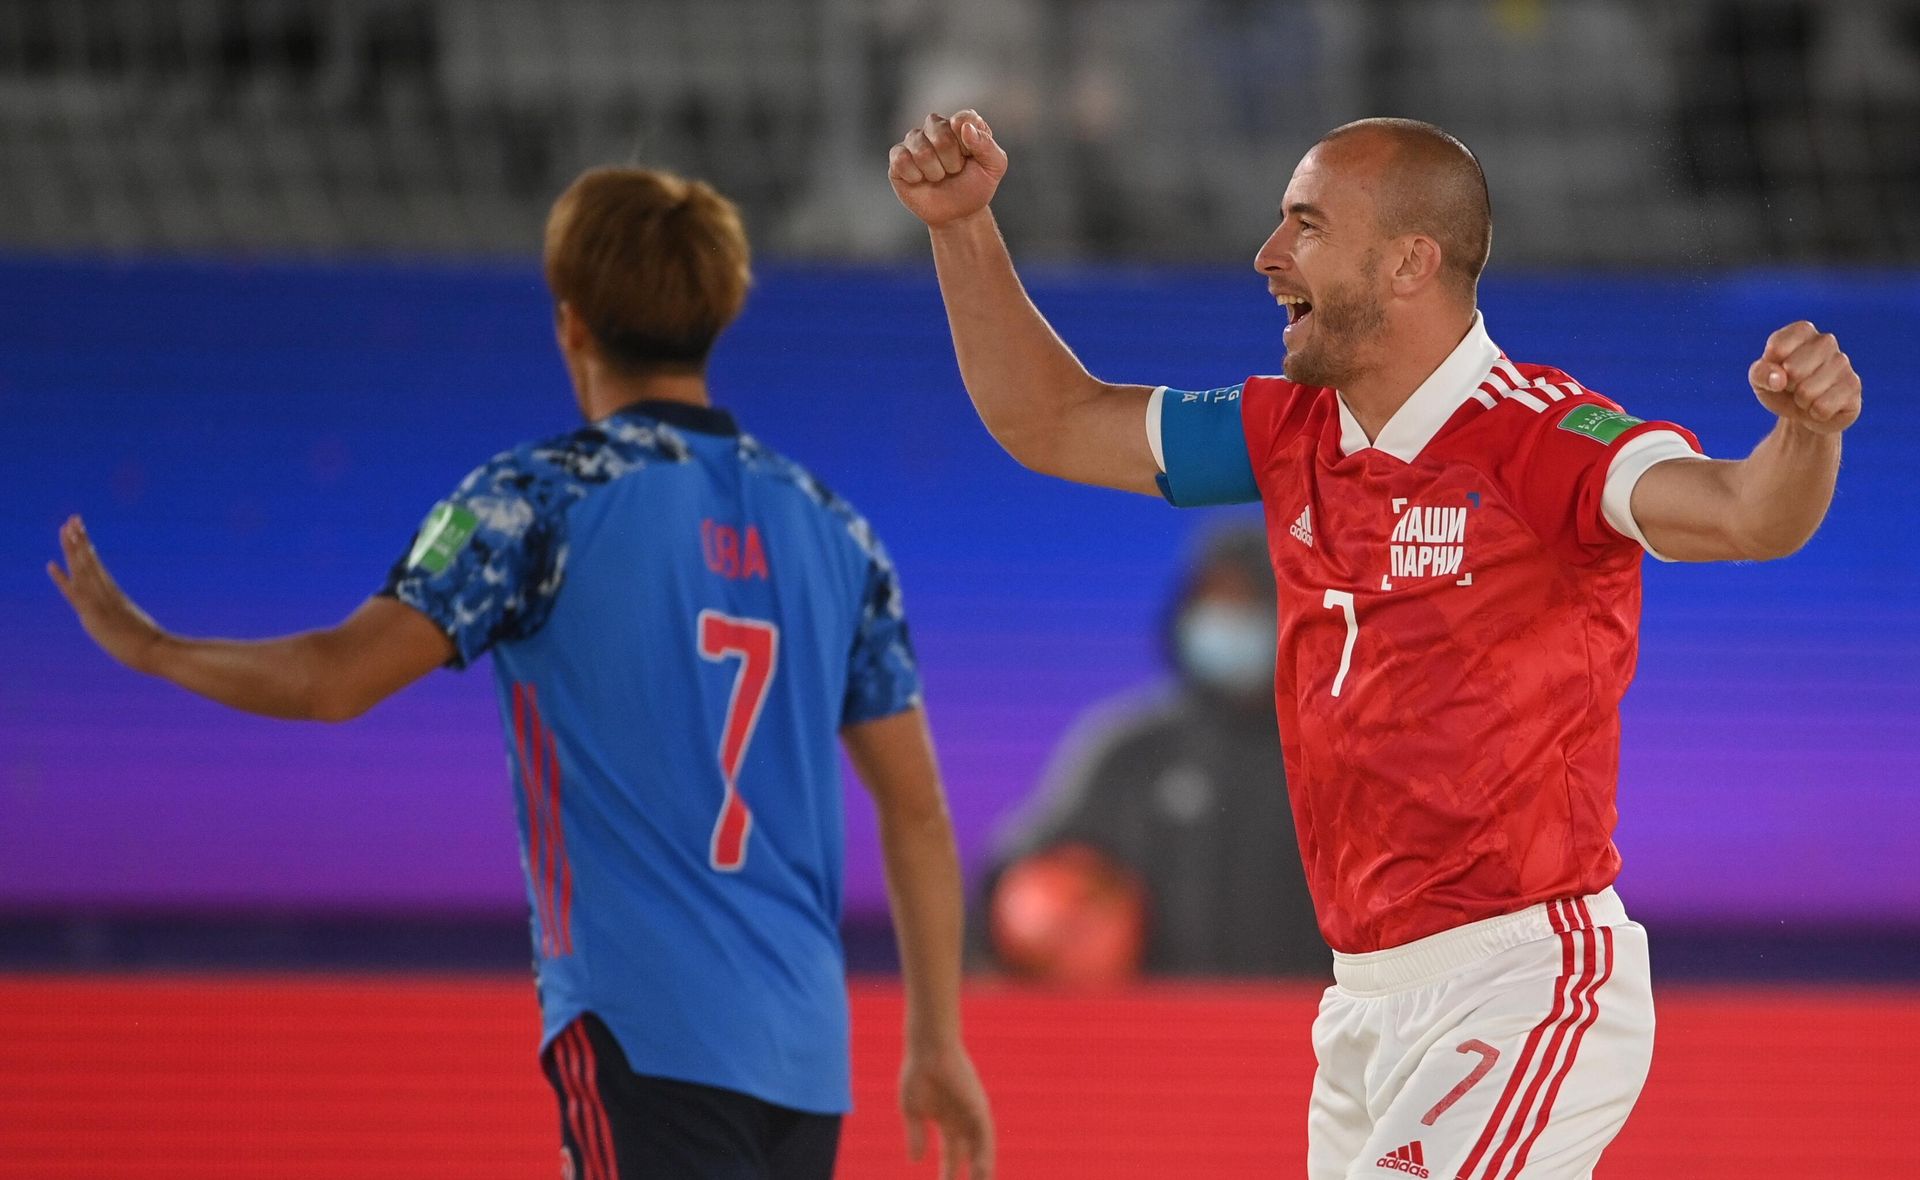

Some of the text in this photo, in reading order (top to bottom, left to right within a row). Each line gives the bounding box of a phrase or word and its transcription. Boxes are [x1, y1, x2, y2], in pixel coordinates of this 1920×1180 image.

[1390, 545, 1464, 577] ПАРНИ
[1323, 588, 1358, 698] 7
[697, 608, 779, 872] 7
[1420, 1038, 1500, 1126] 7
[1376, 1156, 1430, 1179] adidas
